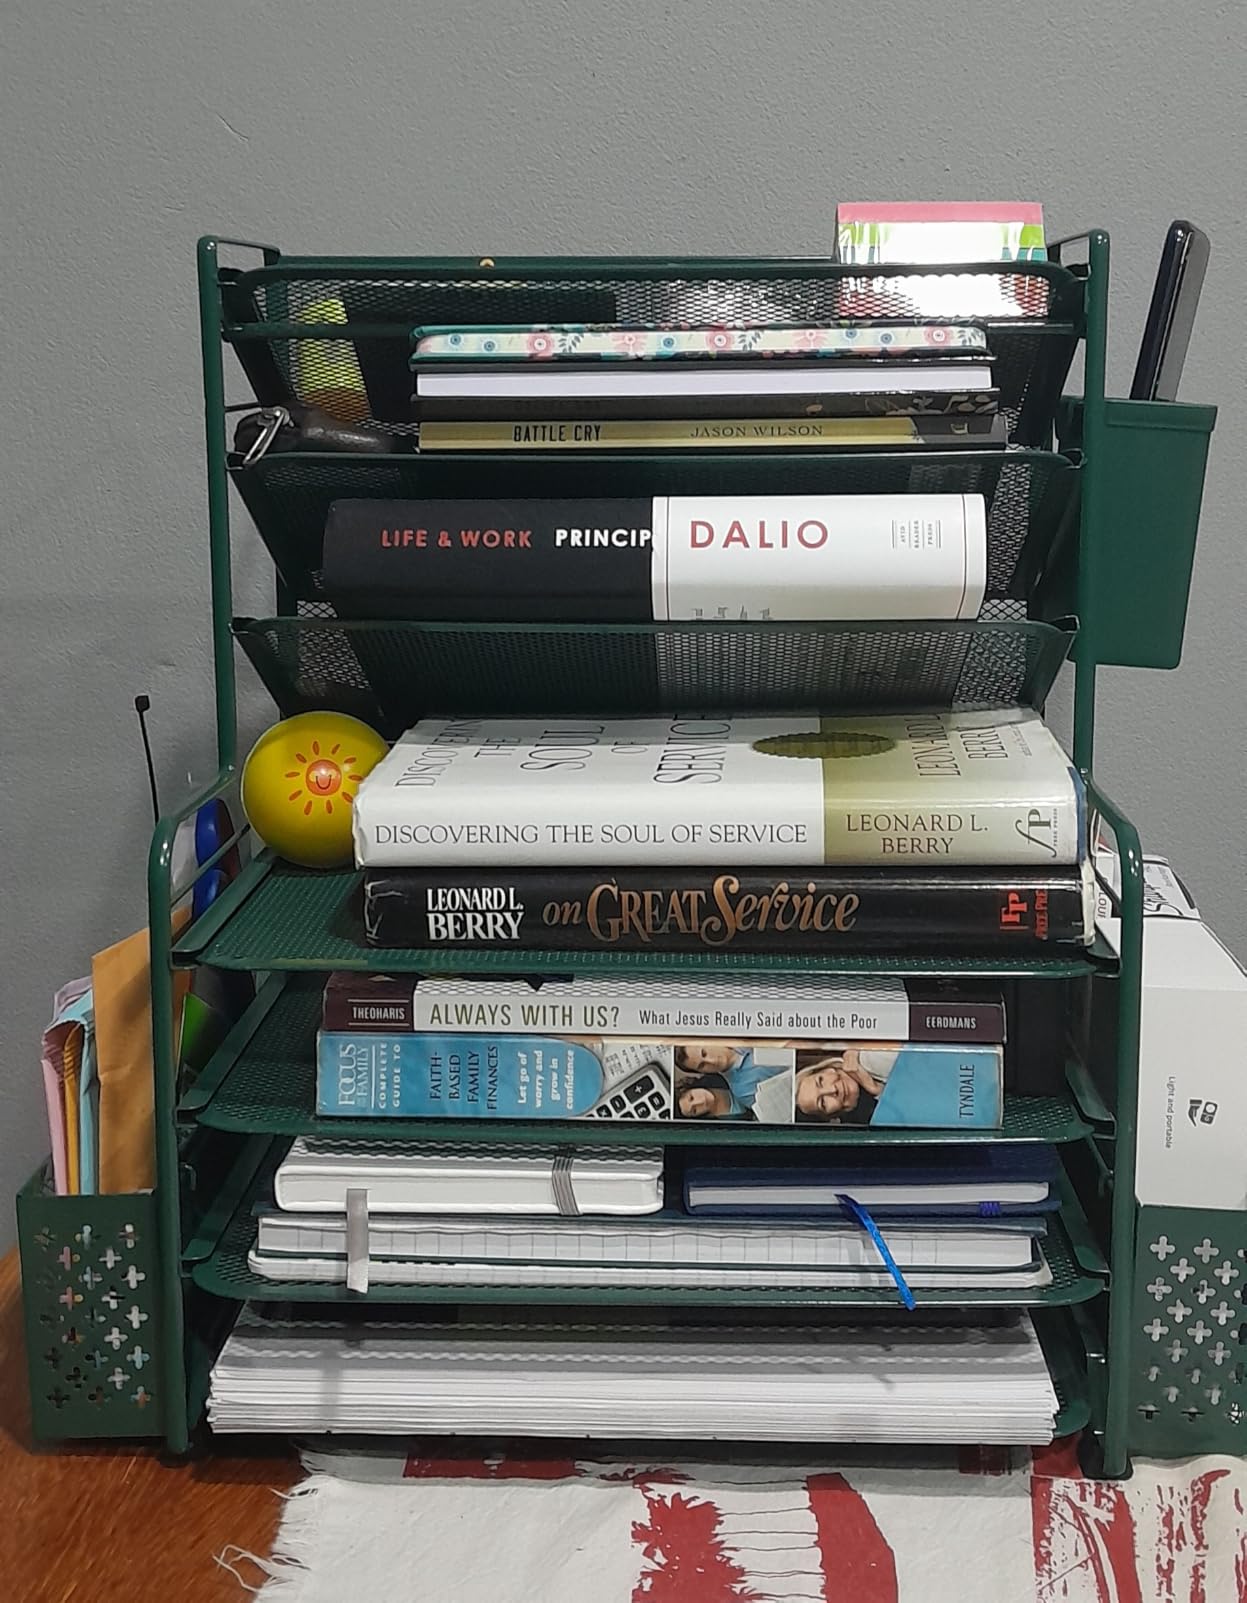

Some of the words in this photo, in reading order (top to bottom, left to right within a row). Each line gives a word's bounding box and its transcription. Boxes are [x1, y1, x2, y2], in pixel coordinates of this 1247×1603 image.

[513, 425, 567, 442] BATTLE
[574, 425, 602, 442] CRY
[690, 426, 746, 438] JASON
[753, 425, 824, 438] WILSON
[382, 529, 428, 548] LIFE
[438, 529, 451, 548] &
[461, 529, 533, 548] WORK
[690, 520, 829, 549] DALIO
[473, 737, 521, 758] THE
[519, 726, 605, 771] SOUL
[906, 723, 961, 777] LEONARD
[375, 825, 539, 844] DISCOVERING
[546, 825, 594, 844] THE
[600, 824, 664, 844] SOUL
[671, 824, 702, 843] OF
[709, 824, 808, 843] SERVICE
[847, 814, 963, 832] LEONARD
[970, 814, 989, 832] L.
[882, 838, 954, 854] BERRY
[426, 887, 507, 911] LEONARD
[509, 887, 524, 910] L.
[542, 901, 582, 926] on
[587, 878, 707, 942] GREAT
[700, 875, 860, 946] Service
[426, 911, 524, 940] BERRY
[352, 1006, 405, 1020] THEOHARIS
[430, 1004, 512, 1026] ALWAYS
[521, 1005, 573, 1027] WITH
[583, 1005, 620, 1028] US?
[639, 1010, 670, 1026] What
[675, 1011, 710, 1026] Jesus
[715, 1011, 752, 1030] Really
[757, 1011, 783, 1028] Said
[788, 1012, 823, 1029] about
[827, 1012, 846, 1029] the
[851, 1013, 878, 1029] Poor
[926, 1016, 977, 1029] EERDMANS
[393, 1044, 401, 1060] TO
[517, 1051, 528, 1065] of
[534, 1050, 543, 1072] and
[549, 1058, 559, 1070] in
[338, 1043, 357, 1105] FOCUS
[357, 1048, 369, 1096] FAMILY
[379, 1041, 388, 1109] COMPLETE
[430, 1051, 442, 1100] FAITH-
[449, 1054, 461, 1100] BASED
[467, 1051, 480, 1103] FAMILY
[487, 1045, 499, 1110] FINANCES
[520, 1068, 530, 1083] go
[564, 1050, 574, 1110] confidence
[393, 1068, 401, 1108] GUIDE
[518, 1085, 527, 1104] Let
[535, 1075, 544, 1108] worry
[551, 1071, 560, 1101] grow
[960, 1064, 975, 1119] TYNDALE
